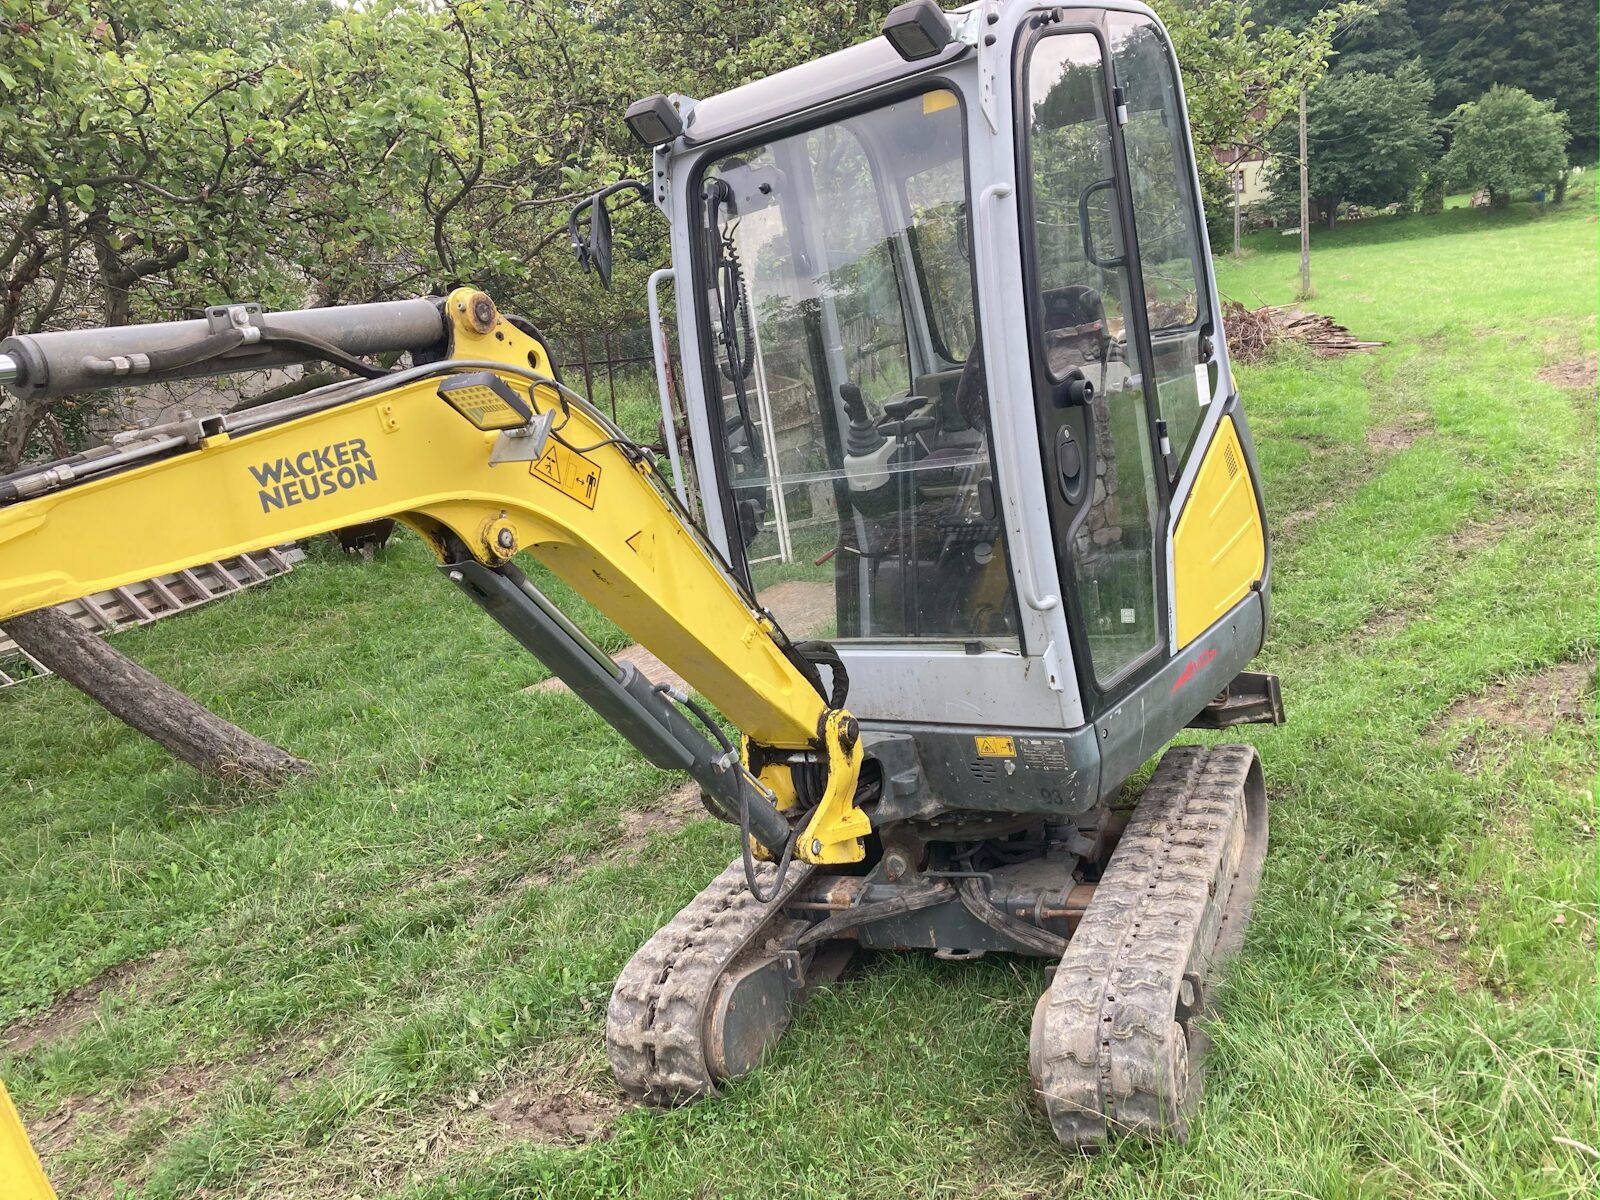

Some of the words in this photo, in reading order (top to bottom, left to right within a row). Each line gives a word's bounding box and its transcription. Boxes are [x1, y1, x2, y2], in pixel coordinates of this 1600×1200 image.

[248, 438, 371, 487] WACKER
[258, 459, 378, 513] NEUSON
[1040, 787, 1064, 805] 93
